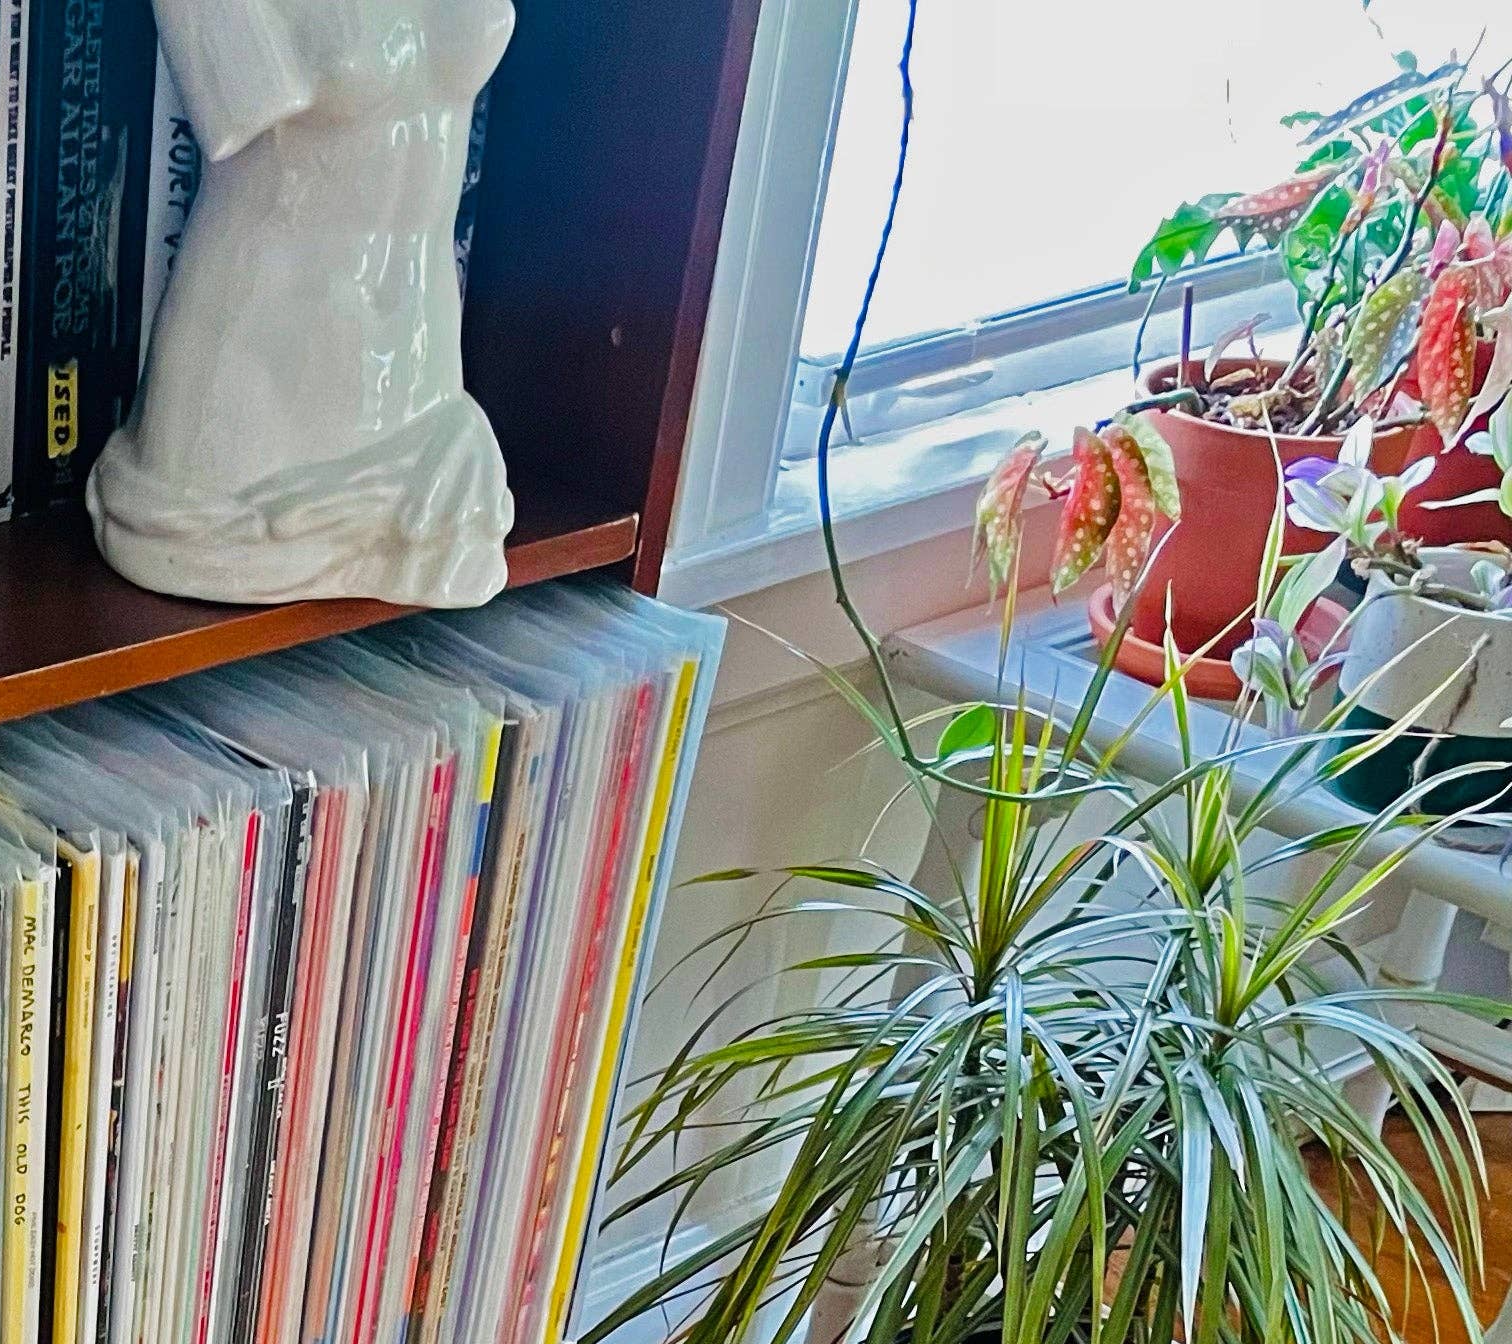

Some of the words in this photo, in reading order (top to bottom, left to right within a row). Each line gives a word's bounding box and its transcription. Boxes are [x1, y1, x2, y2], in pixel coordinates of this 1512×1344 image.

[55, 99, 82, 242] ALLAN
[167, 115, 194, 217] KURT
[51, 249, 75, 339] POE
[22, 914, 39, 956] MAC
[19, 964, 37, 1058] DEMARCO
[271, 1010, 290, 1060] FUZZ
[16, 1082, 32, 1124] THIS
[14, 1143, 29, 1176] OLD
[13, 1192, 28, 1227] DOG
